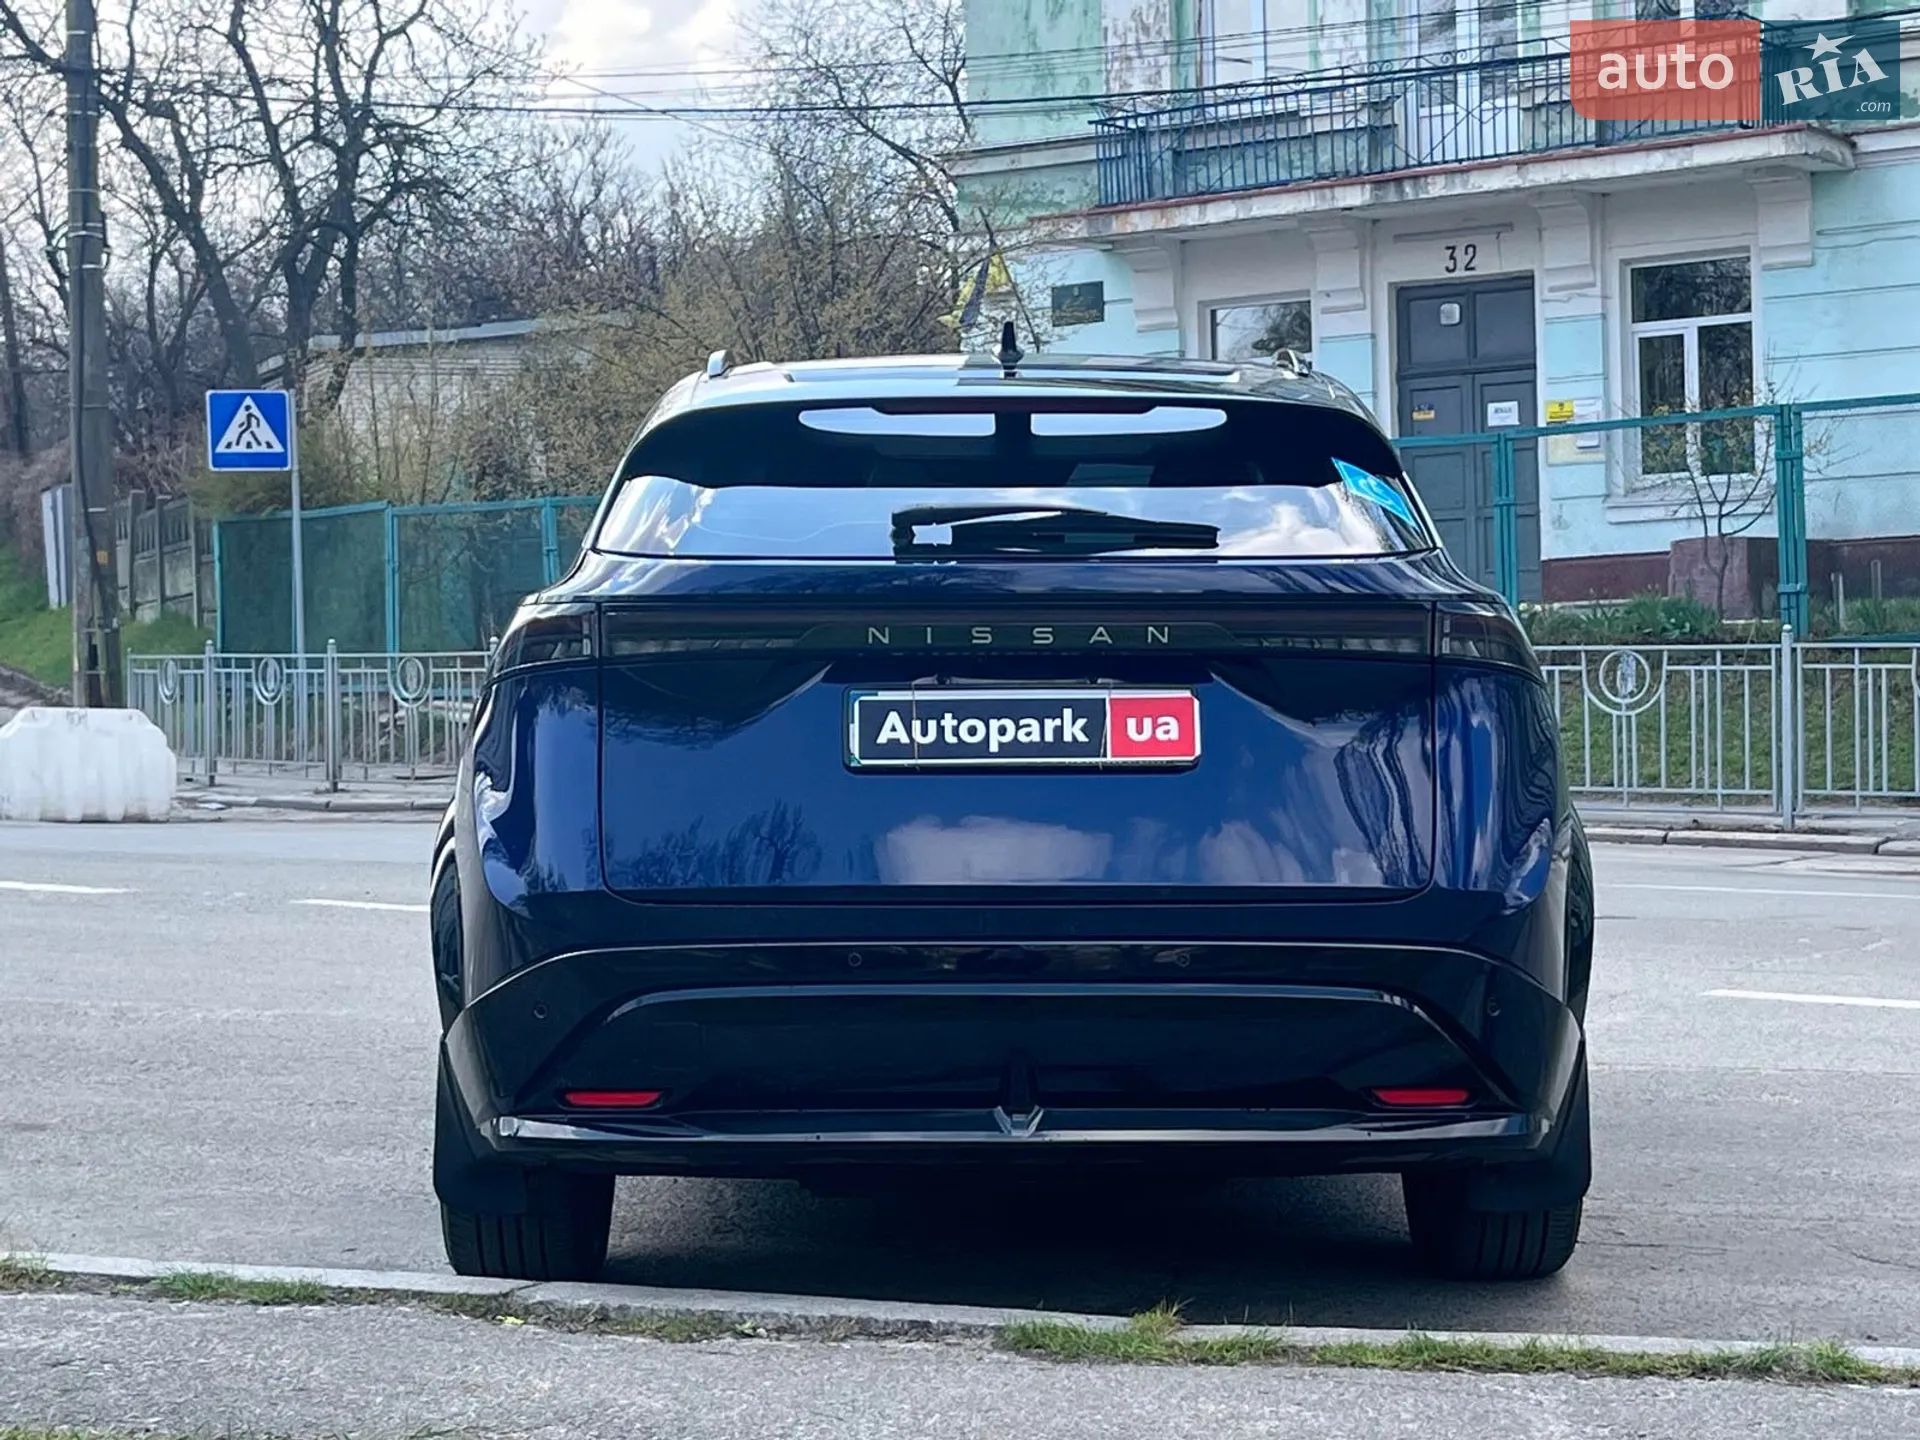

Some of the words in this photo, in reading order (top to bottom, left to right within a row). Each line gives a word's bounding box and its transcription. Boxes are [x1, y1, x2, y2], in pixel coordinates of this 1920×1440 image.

[1445, 244, 1477, 273] 32
[867, 626, 1169, 644] NISSAN
[876, 708, 1089, 752] Autopark
[1127, 715, 1180, 742] ua
